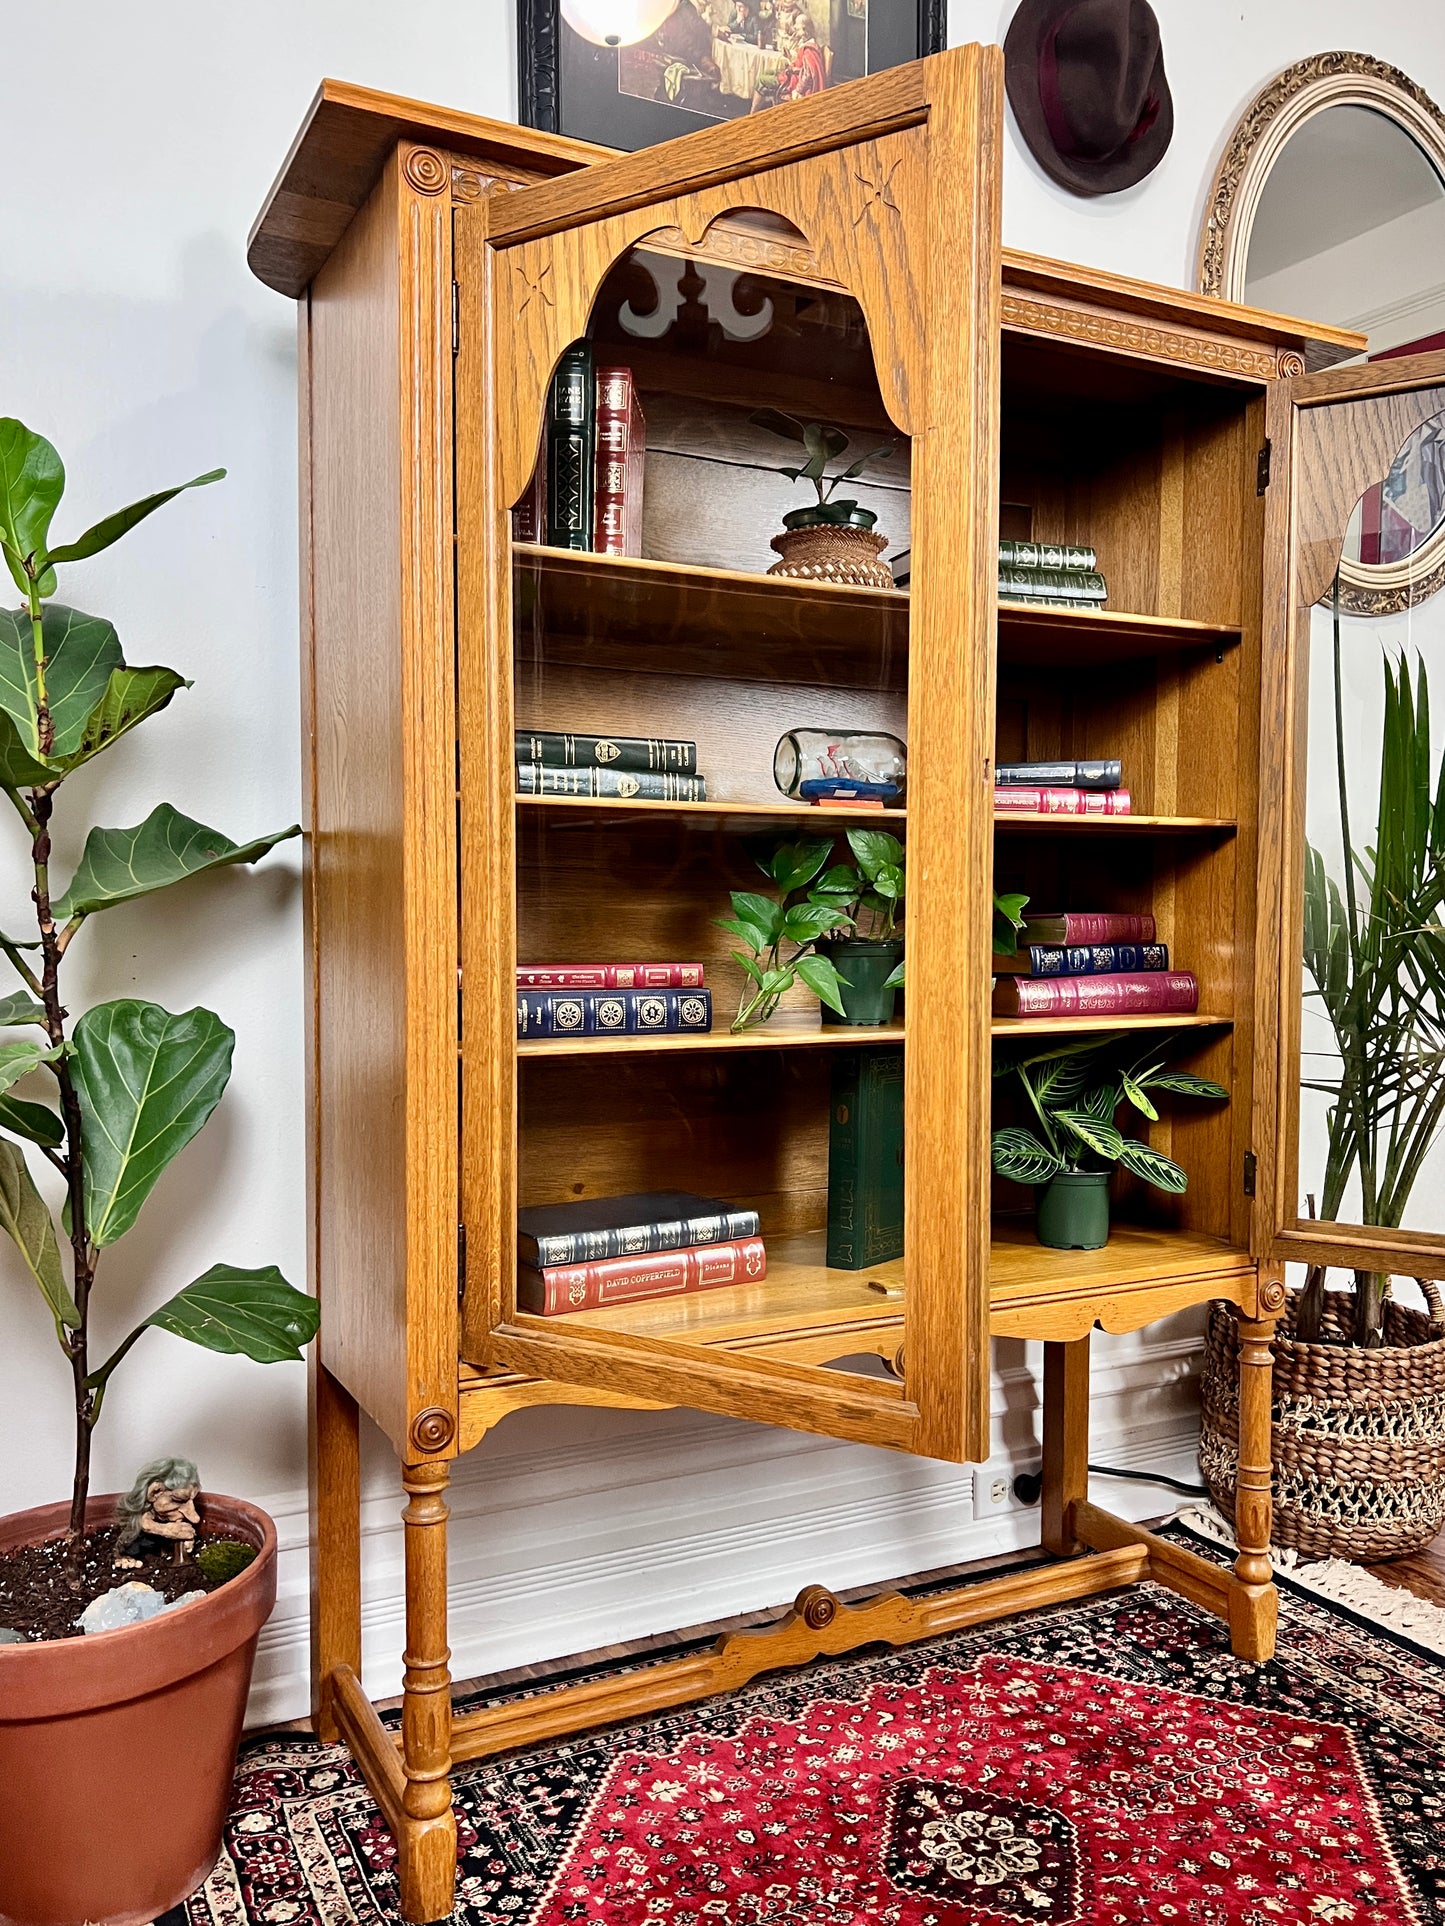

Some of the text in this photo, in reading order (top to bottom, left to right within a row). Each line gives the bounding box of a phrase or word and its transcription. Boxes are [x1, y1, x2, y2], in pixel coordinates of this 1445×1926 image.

[558, 386, 581, 395] JANE
[558, 395, 582, 404] EYRE
[704, 1263, 730, 1272] Dickens
[606, 1268, 681, 1289] DAVID COPPERFIELD
